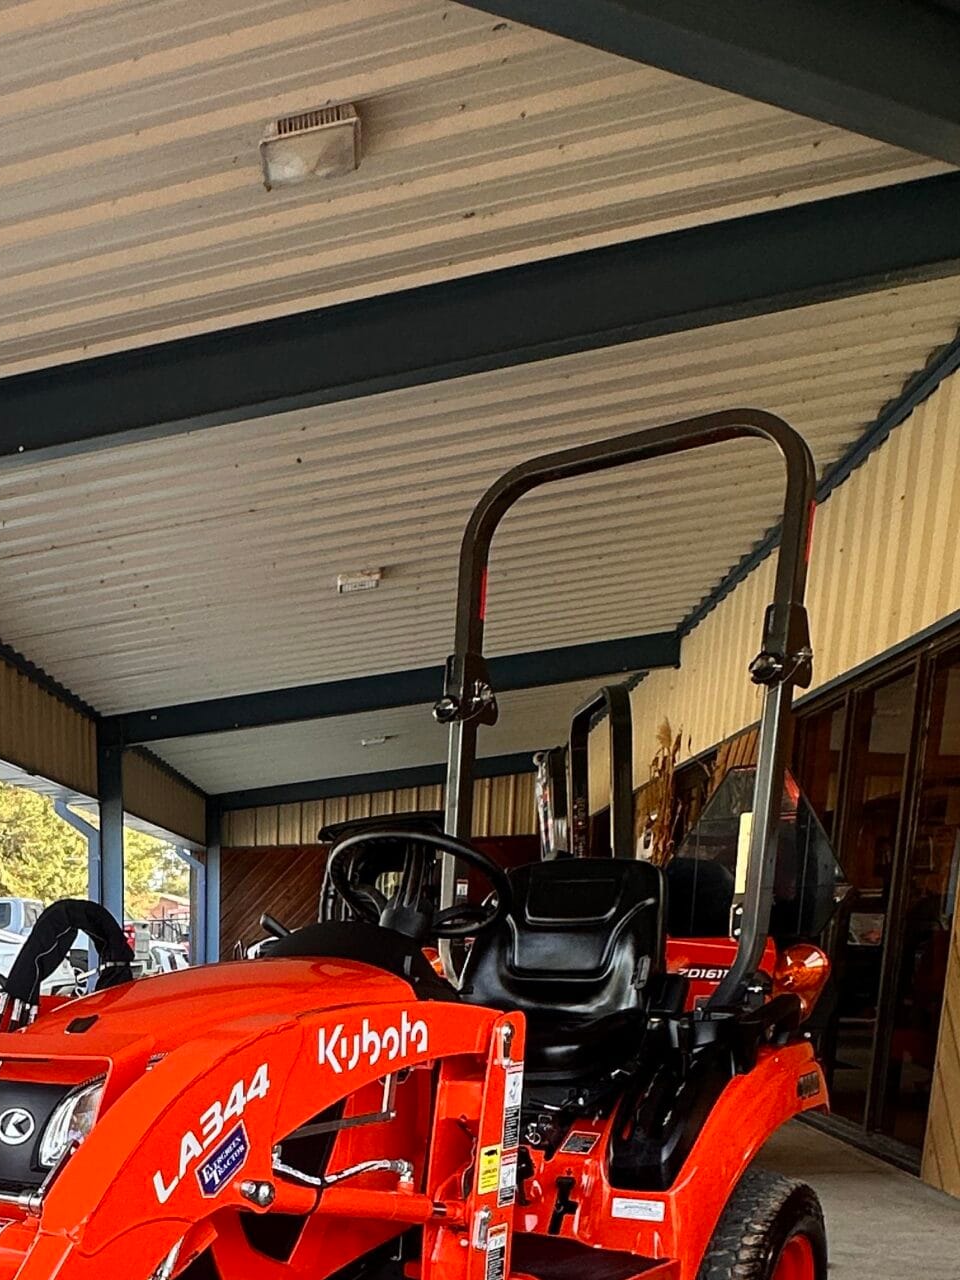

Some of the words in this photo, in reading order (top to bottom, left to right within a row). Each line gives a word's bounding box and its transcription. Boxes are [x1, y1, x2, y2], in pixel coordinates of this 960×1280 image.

[318, 1011, 429, 1074] Kubota
[153, 1063, 270, 1204] LA344
[211, 1144, 246, 1185] TRACTOR
